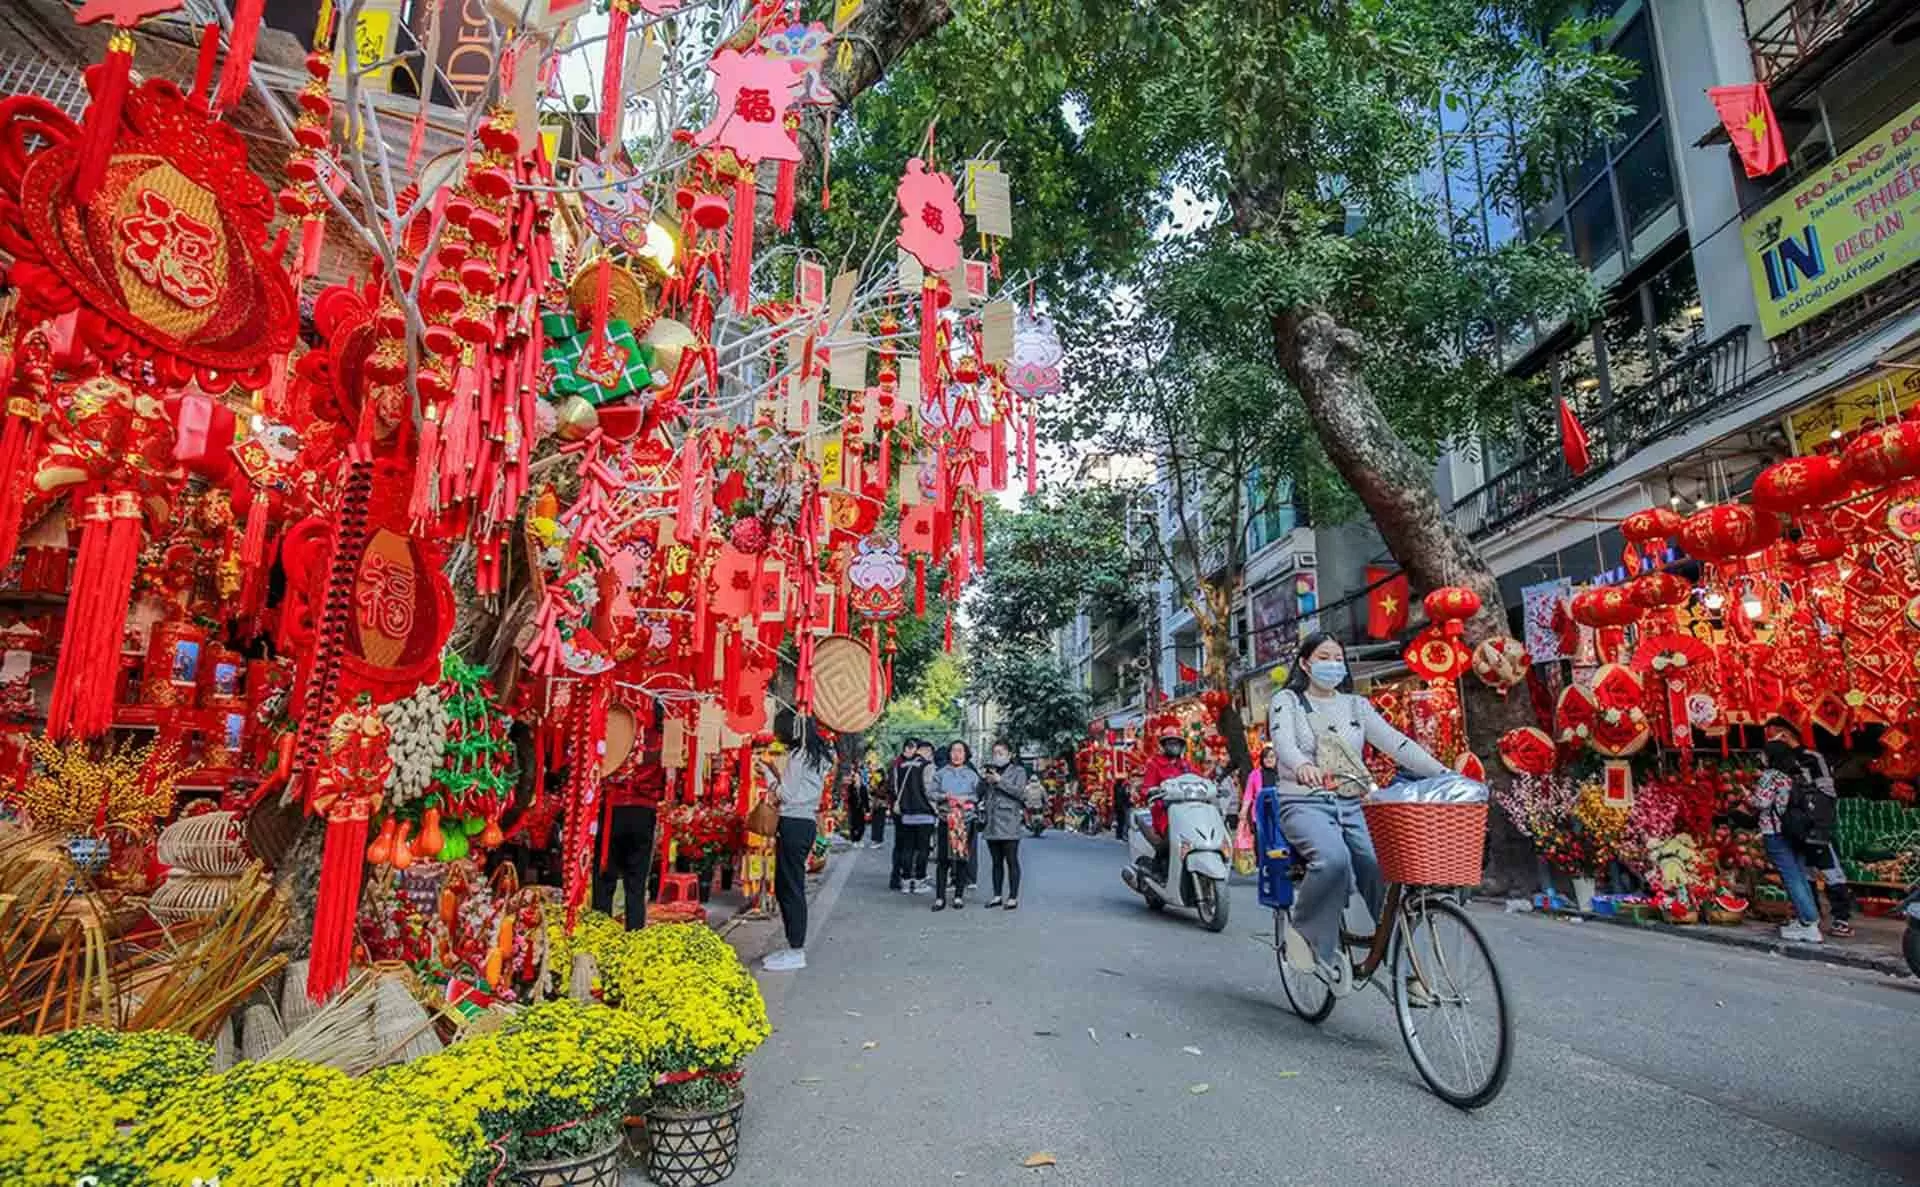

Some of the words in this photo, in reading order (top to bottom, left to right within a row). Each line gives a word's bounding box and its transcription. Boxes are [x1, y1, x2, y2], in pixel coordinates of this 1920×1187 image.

[735, 86, 776, 123] 福
[1761, 223, 1826, 302] IN
[1834, 210, 1905, 265] DECAN
